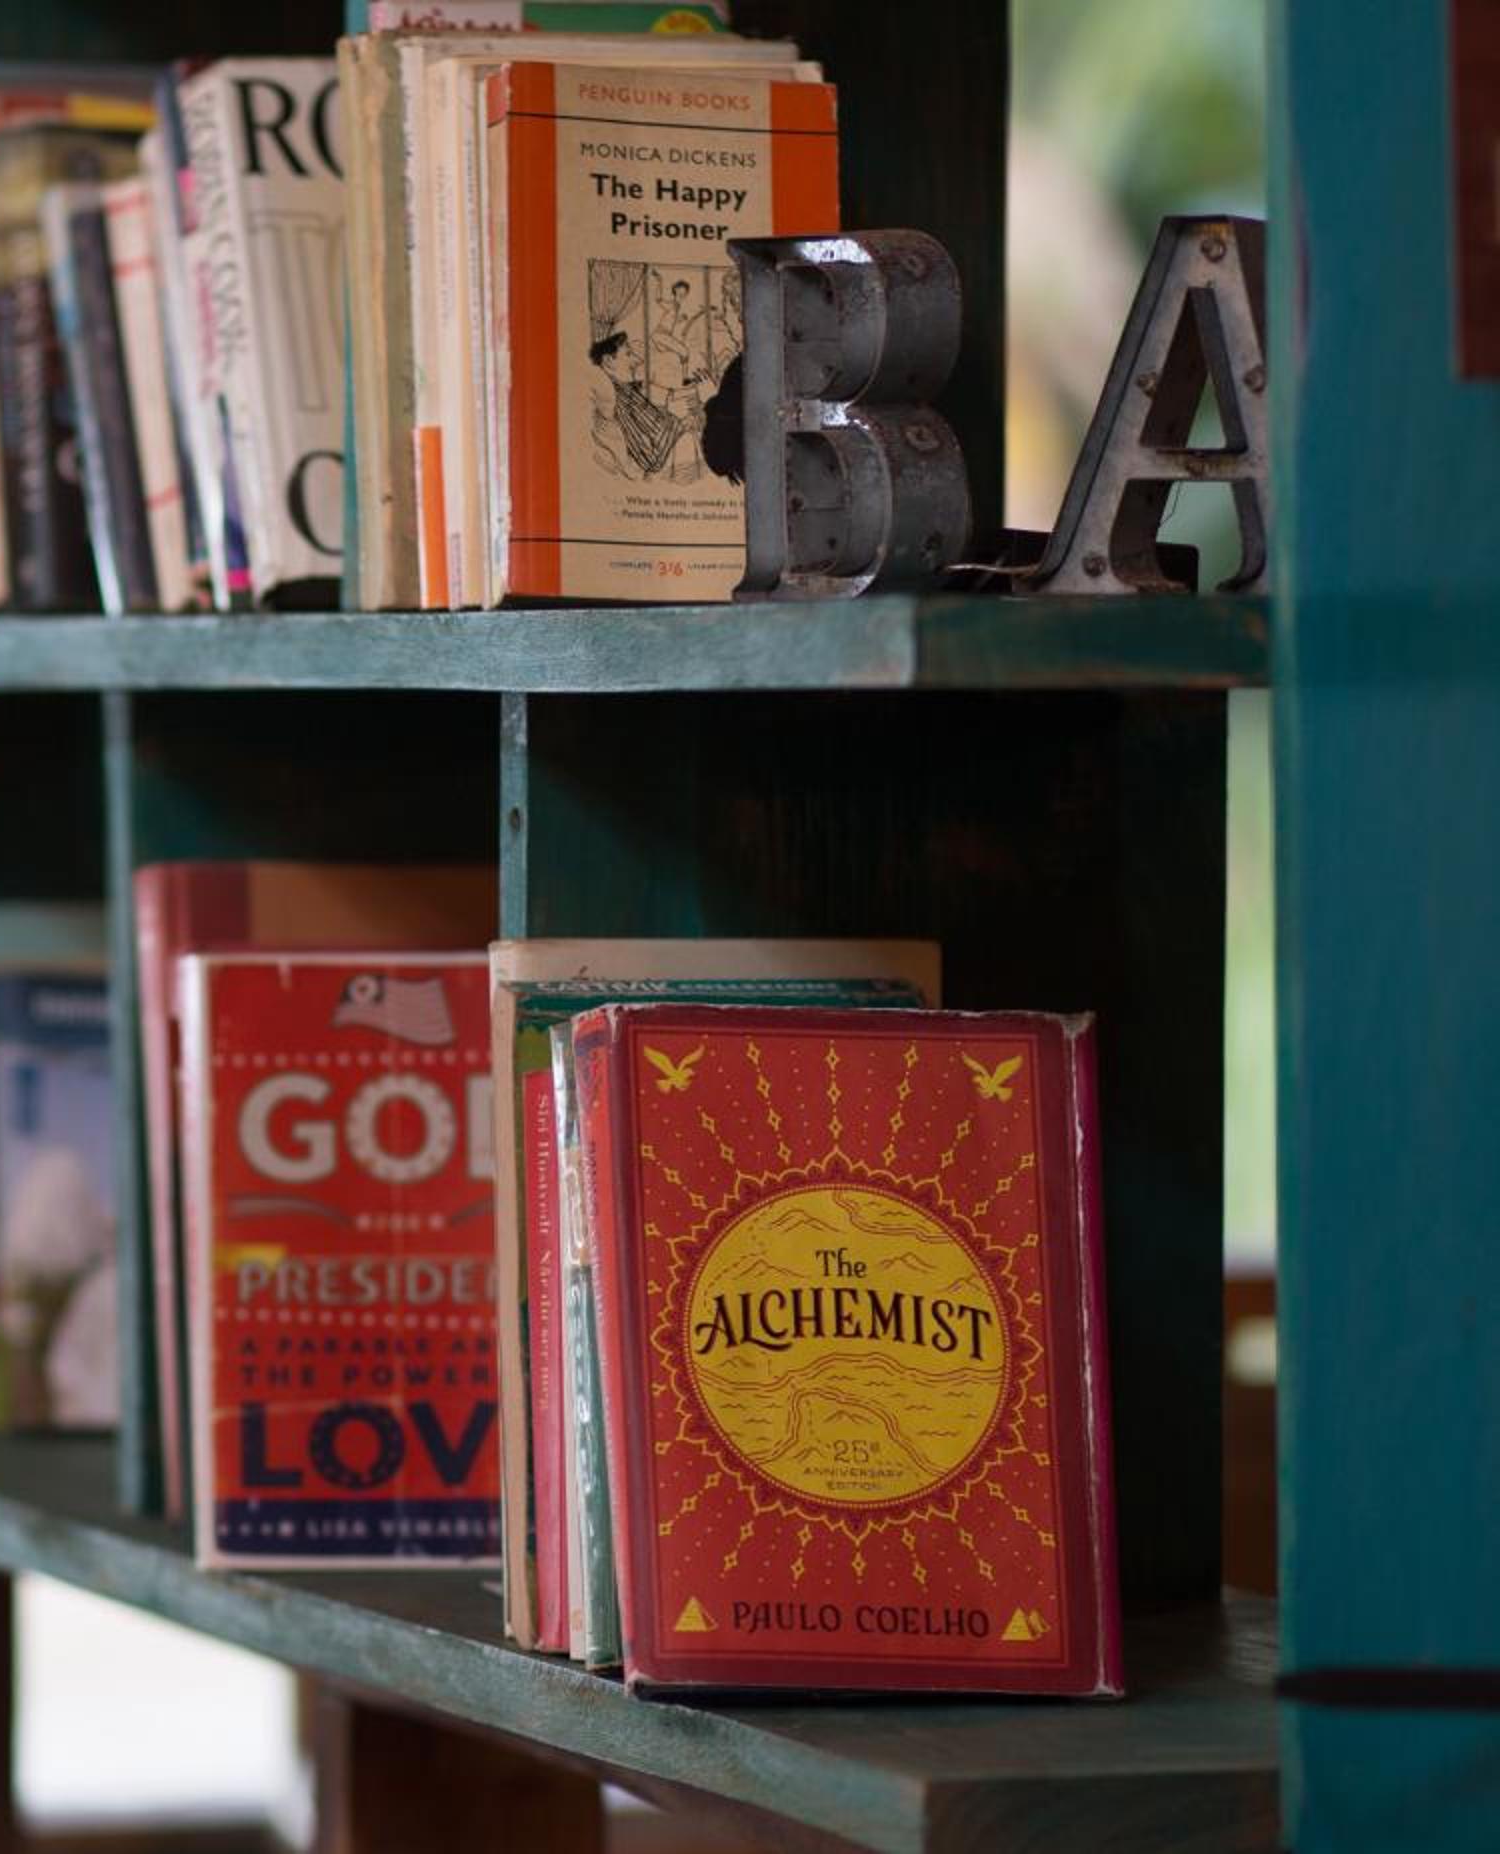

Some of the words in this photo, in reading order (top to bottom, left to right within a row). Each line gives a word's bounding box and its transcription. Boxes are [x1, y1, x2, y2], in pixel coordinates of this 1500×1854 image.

[579, 84, 672, 106] PENGUIN
[682, 92, 751, 111] BOOKS
[580, 142, 662, 163] MONICA
[668, 148, 757, 168] DICKENS
[590, 173, 644, 199] The
[655, 178, 748, 212] Happy
[611, 211, 729, 240] Prisoner
[815, 1247, 869, 1279] The
[694, 1286, 992, 1361] ALCHEMIST
[452, 1337, 492, 1355] AB
[240, 1364, 316, 1387] THE
[342, 1364, 492, 1388] POWER
[241, 1399, 498, 1491] LOV
[732, 1600, 842, 1633] PAULO
[854, 1604, 991, 1638] COELHO
